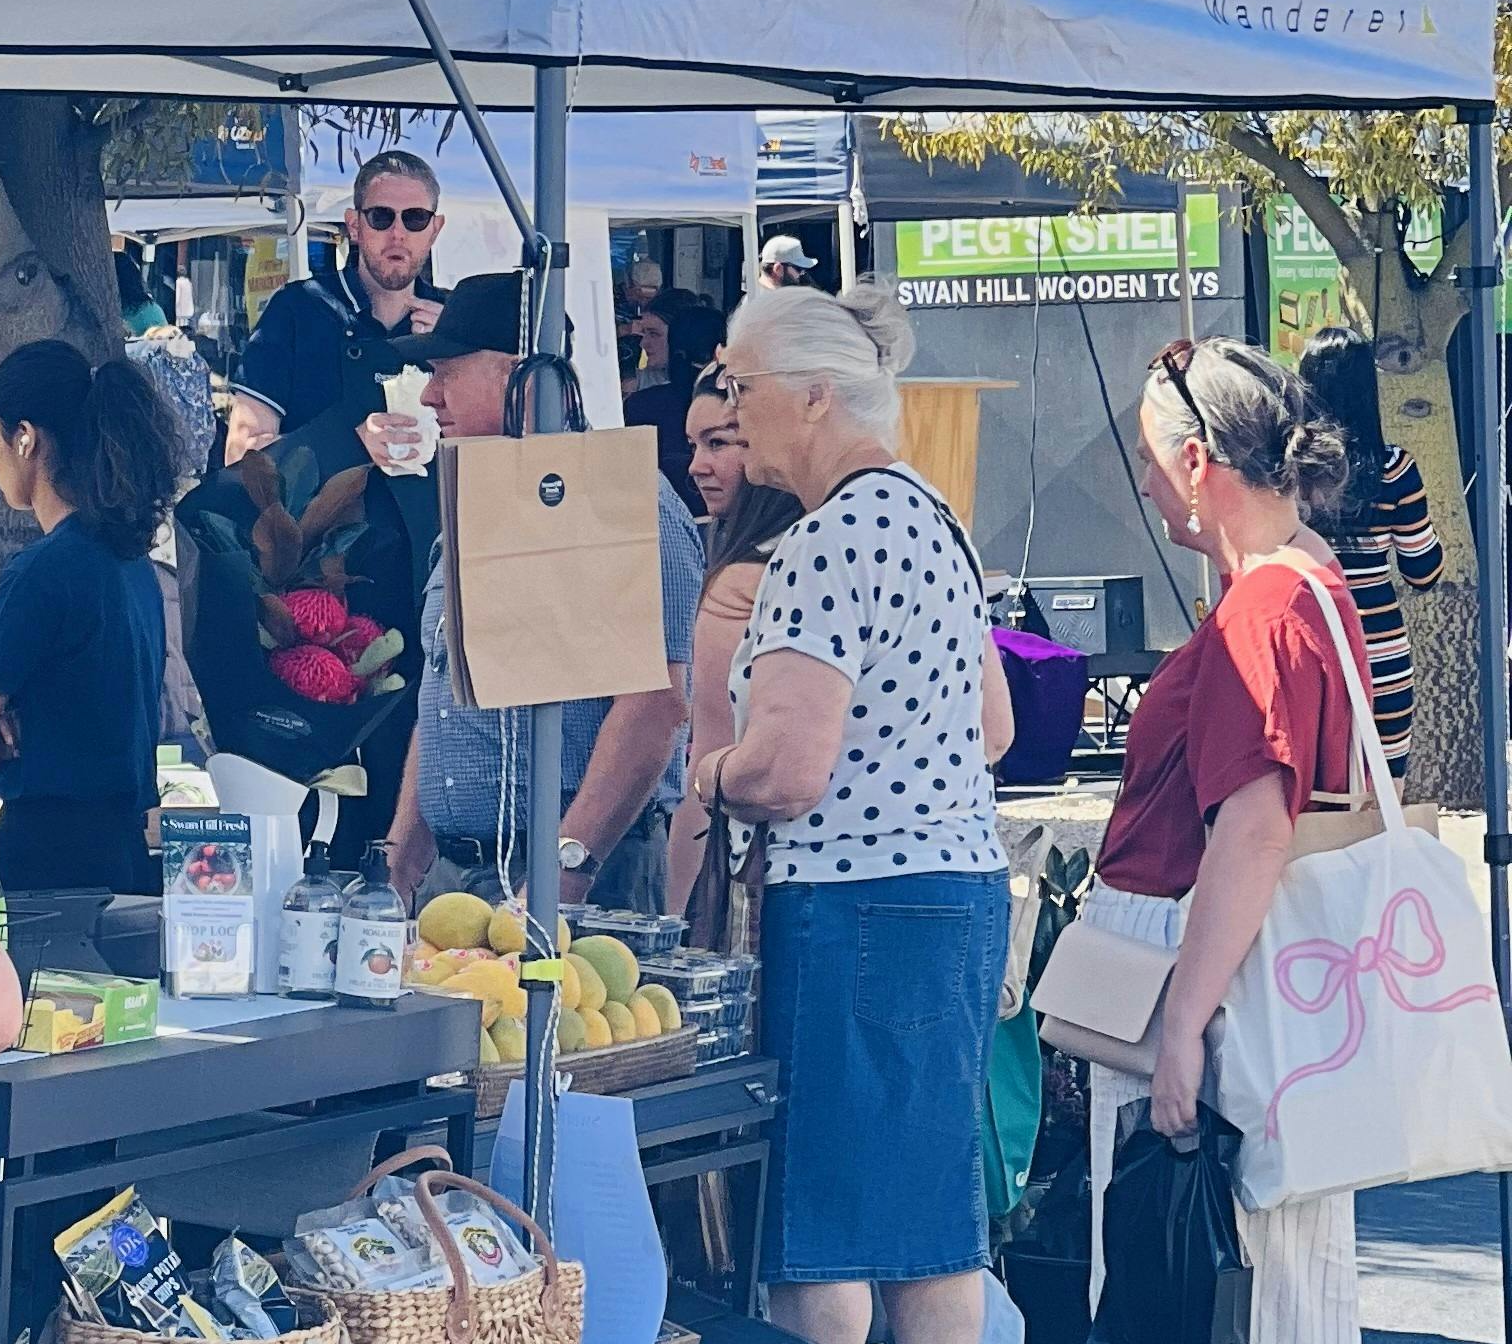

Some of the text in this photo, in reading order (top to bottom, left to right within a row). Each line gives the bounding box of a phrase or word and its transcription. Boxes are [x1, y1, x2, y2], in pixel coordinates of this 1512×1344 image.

[920, 216, 1054, 257] PEG'S
[897, 271, 1220, 306] SWAN HILL WOODEN TOYS
